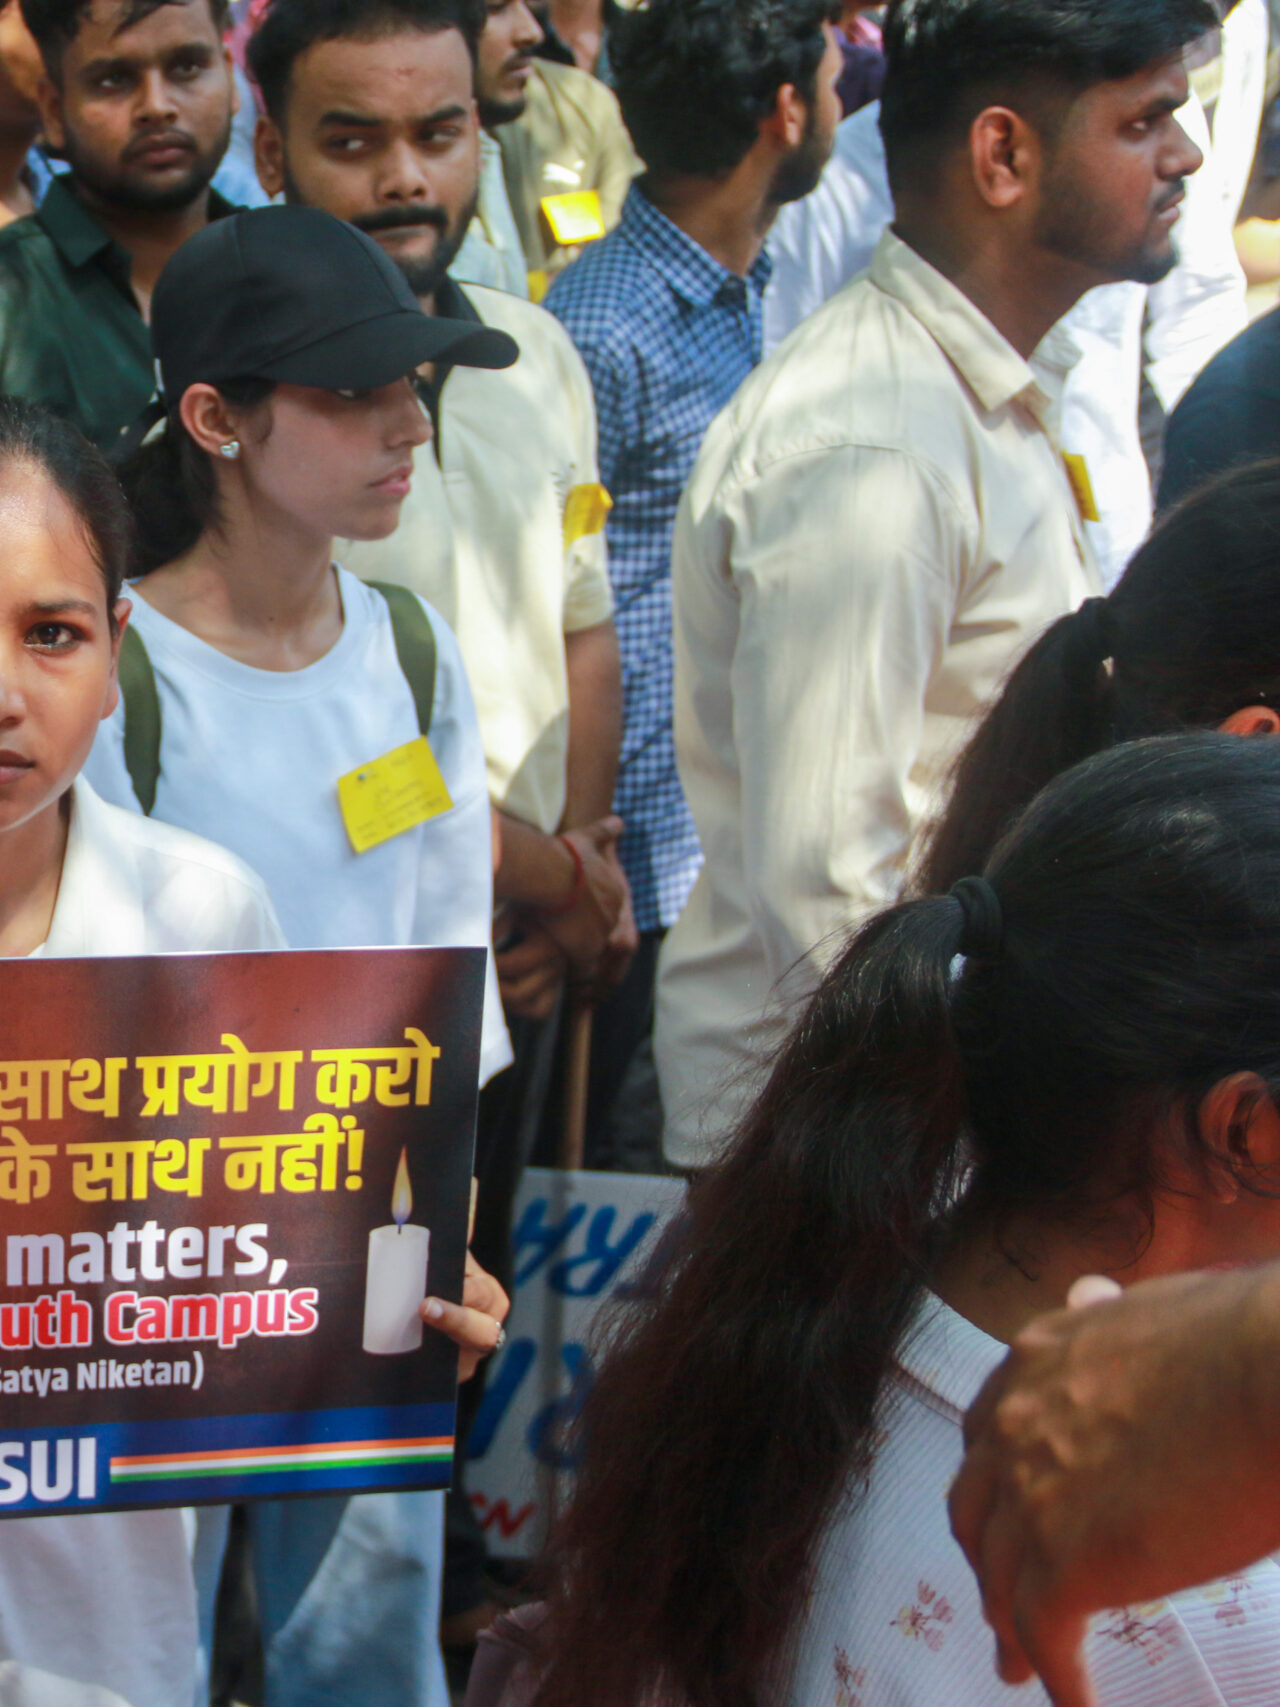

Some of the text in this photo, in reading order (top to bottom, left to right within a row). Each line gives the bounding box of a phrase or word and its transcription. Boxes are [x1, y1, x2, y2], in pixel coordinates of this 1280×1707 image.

[136, 1033, 304, 1117] प्रयोग
[311, 1027, 442, 1109] करो
[65, 1138, 212, 1203] साथ
[219, 1112, 365, 1195] नहीं!
[6, 1220, 288, 1287] matters,
[104, 1287, 319, 1349] Campus
[76, 1350, 205, 1391] Niketan)
